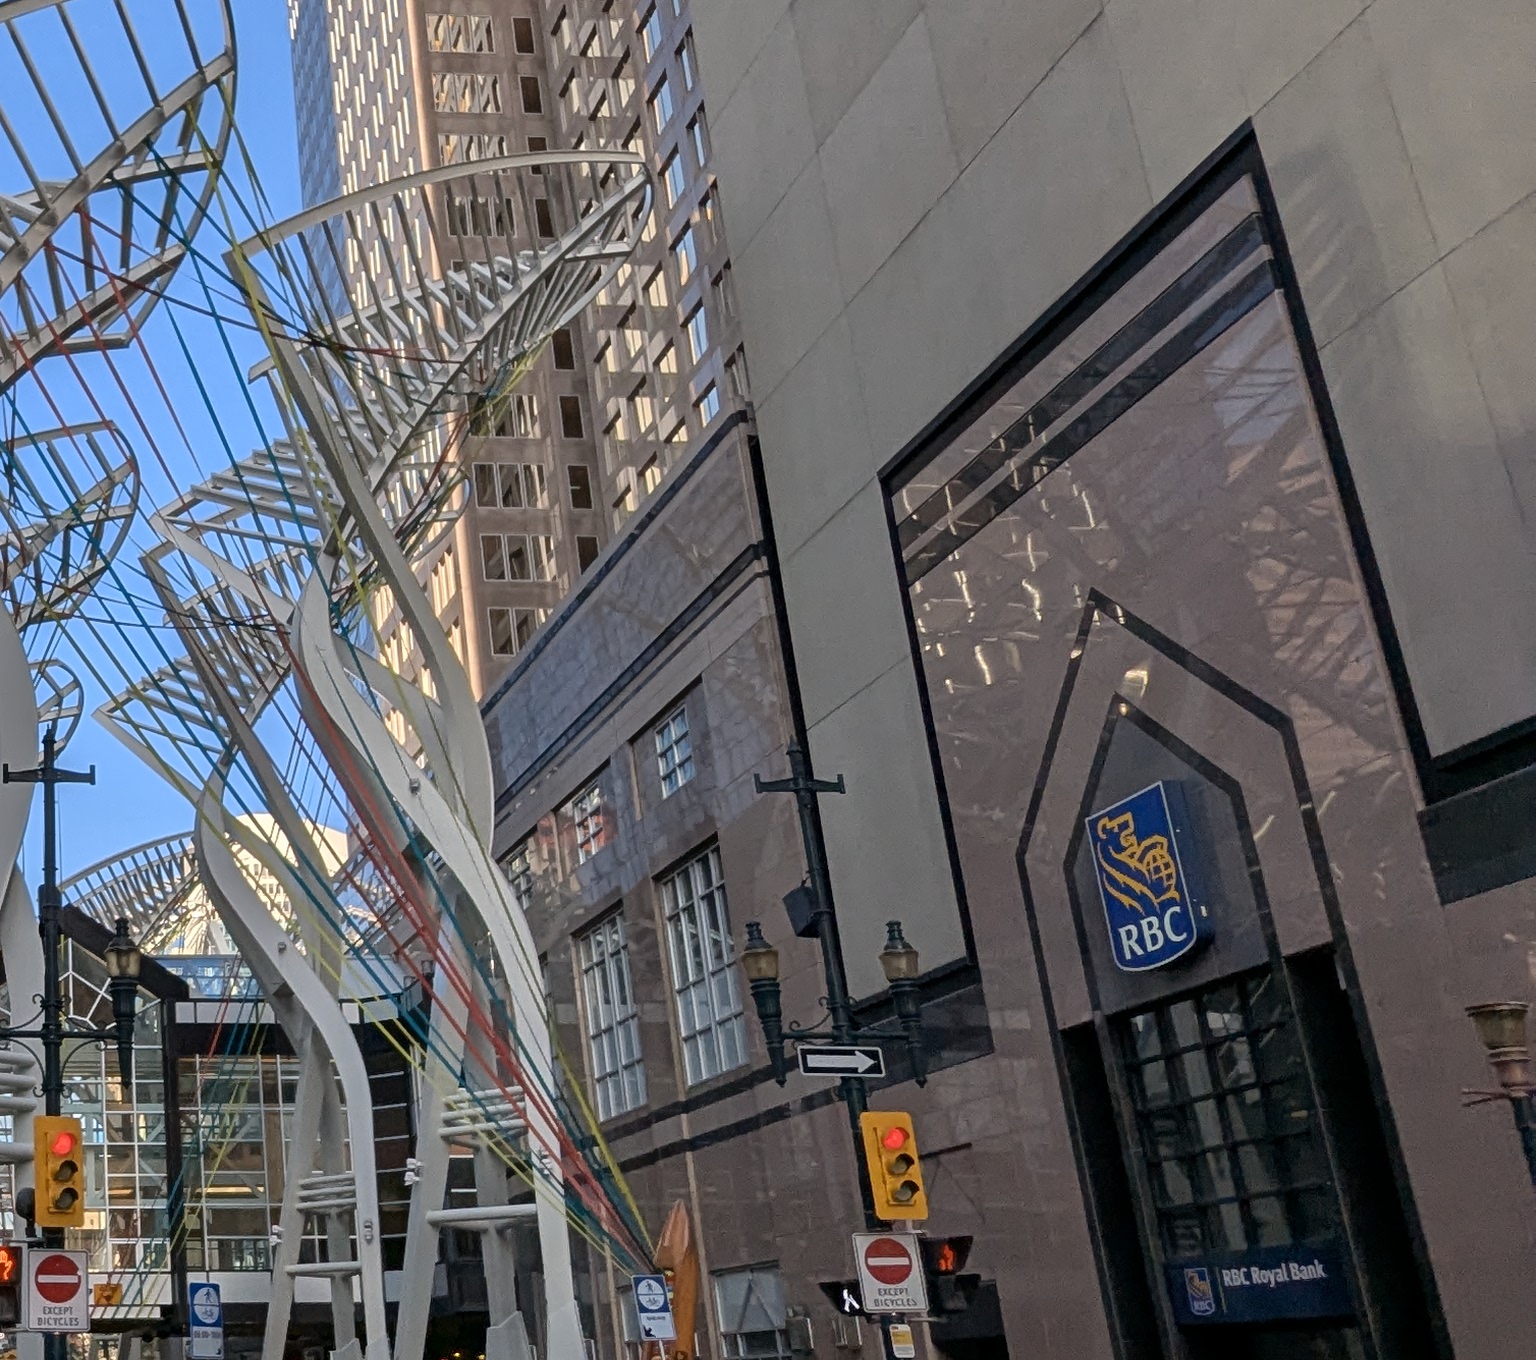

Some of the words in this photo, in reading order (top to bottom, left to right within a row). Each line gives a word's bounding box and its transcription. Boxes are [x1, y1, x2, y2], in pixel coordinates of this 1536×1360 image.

[1118, 905, 1187, 960] RBC
[1221, 1267, 1251, 1288] RBC
[1250, 1262, 1290, 1288] Royal
[1288, 1259, 1328, 1281] Bank
[878, 1288, 909, 1296] EXCEPT
[874, 1298, 918, 1307] BICYCLES
[42, 1306, 74, 1316] EXCEPT
[37, 1317, 80, 1327] BICYCLES
